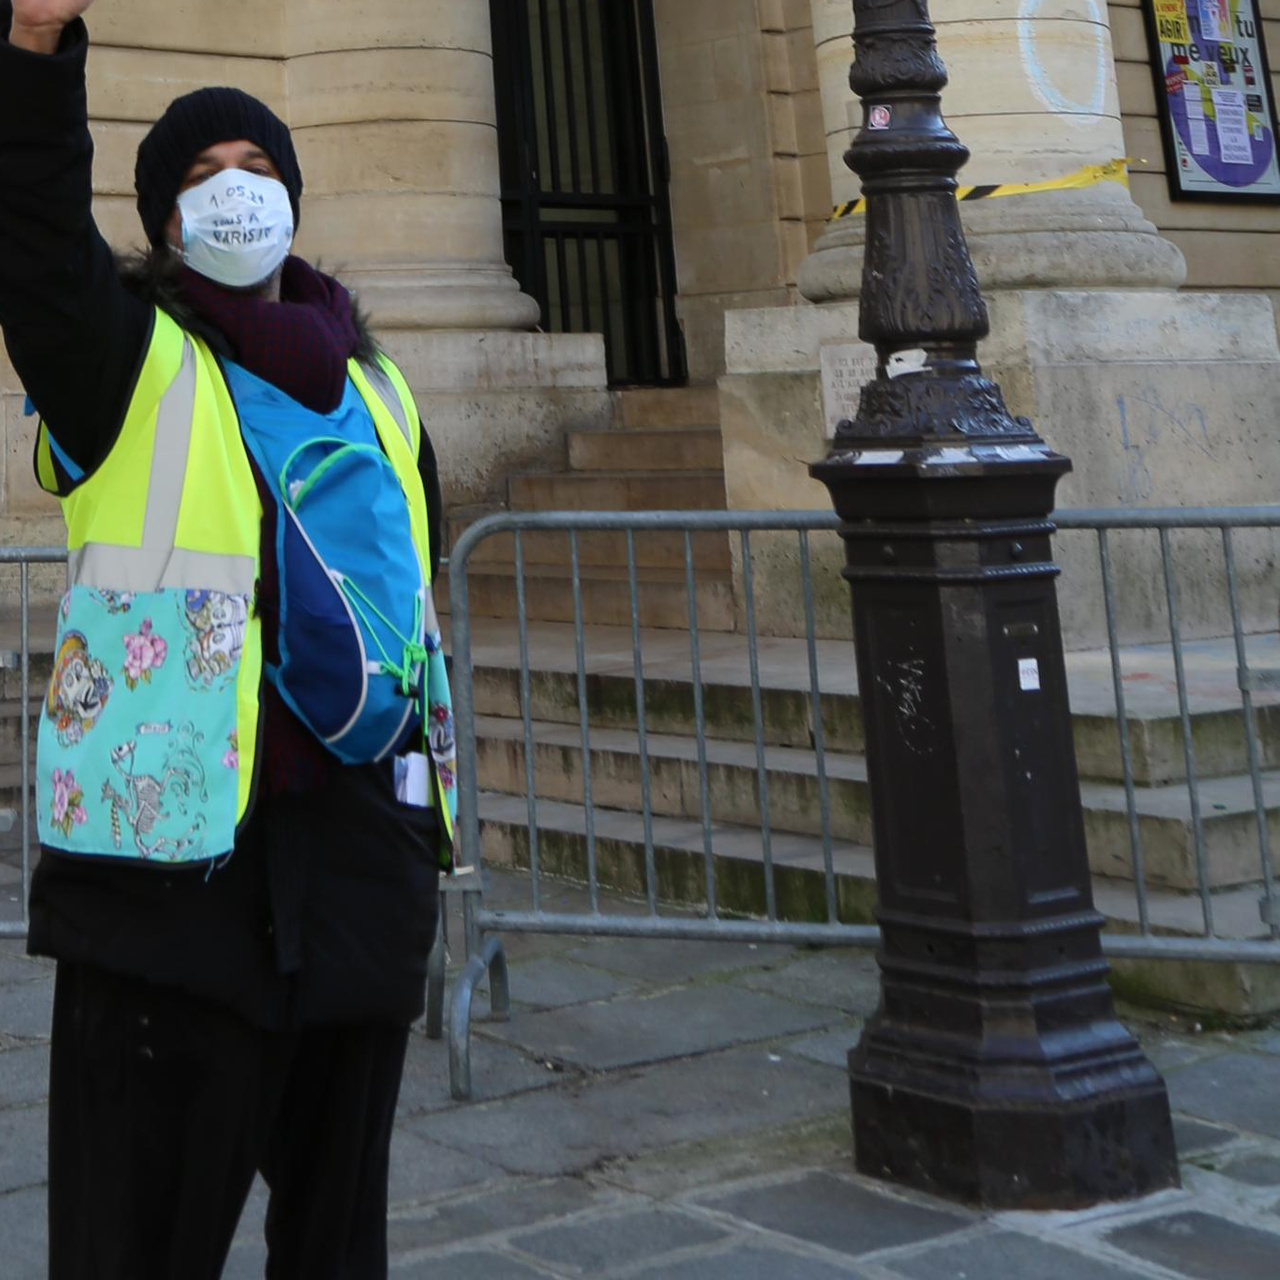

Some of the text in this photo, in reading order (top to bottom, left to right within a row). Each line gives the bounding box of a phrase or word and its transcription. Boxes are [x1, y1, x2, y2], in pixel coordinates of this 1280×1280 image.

[1235, 13, 1255, 38] tu
[1171, 42, 1252, 67] me veux
